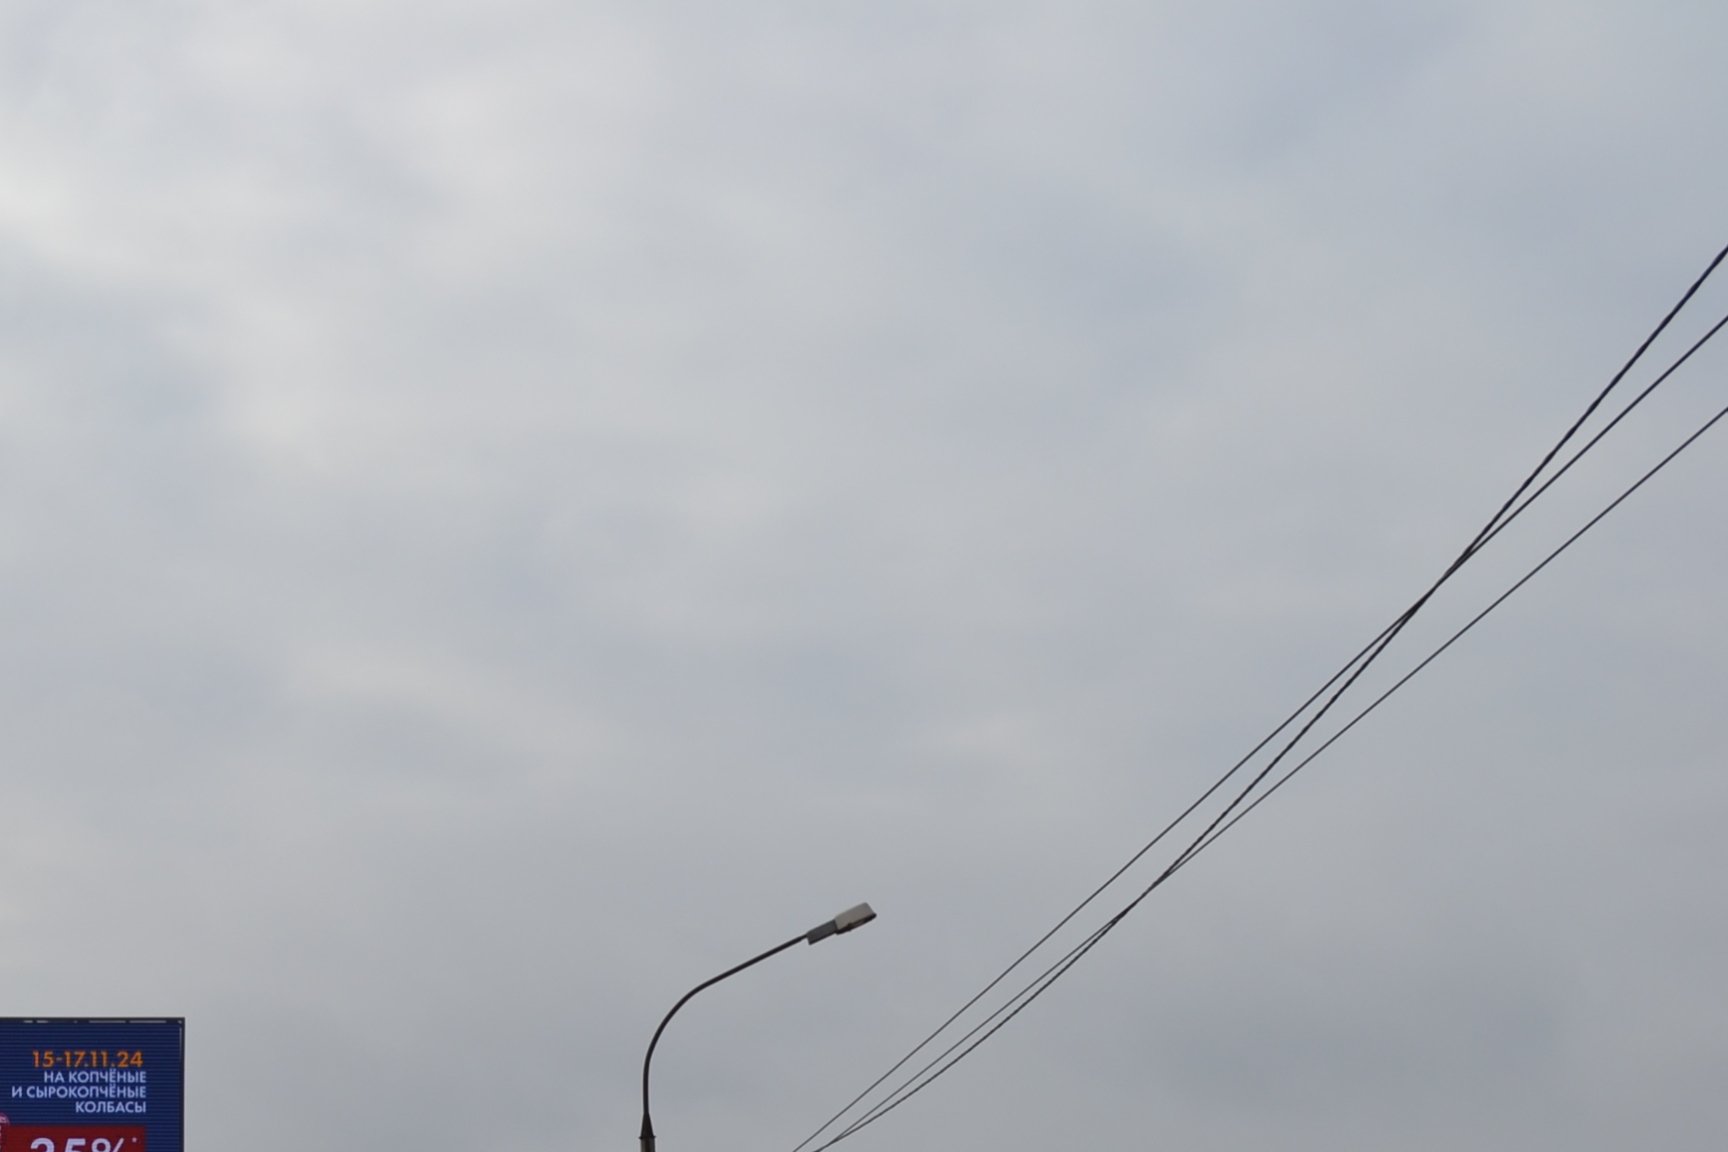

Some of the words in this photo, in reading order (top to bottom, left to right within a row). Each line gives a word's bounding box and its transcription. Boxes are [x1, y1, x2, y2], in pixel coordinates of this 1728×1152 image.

[32, 1051, 144, 1068] 15-17.11.24
[43, 1071, 65, 1083] НА
[68, 1068, 147, 1083] КОПЧЁНЫЕ
[11, 1086, 22, 1098] И
[26, 1083, 147, 1098] СЫРОКОПЧЁНЫЕ
[75, 1101, 147, 1113] КОЛБАСЫ
